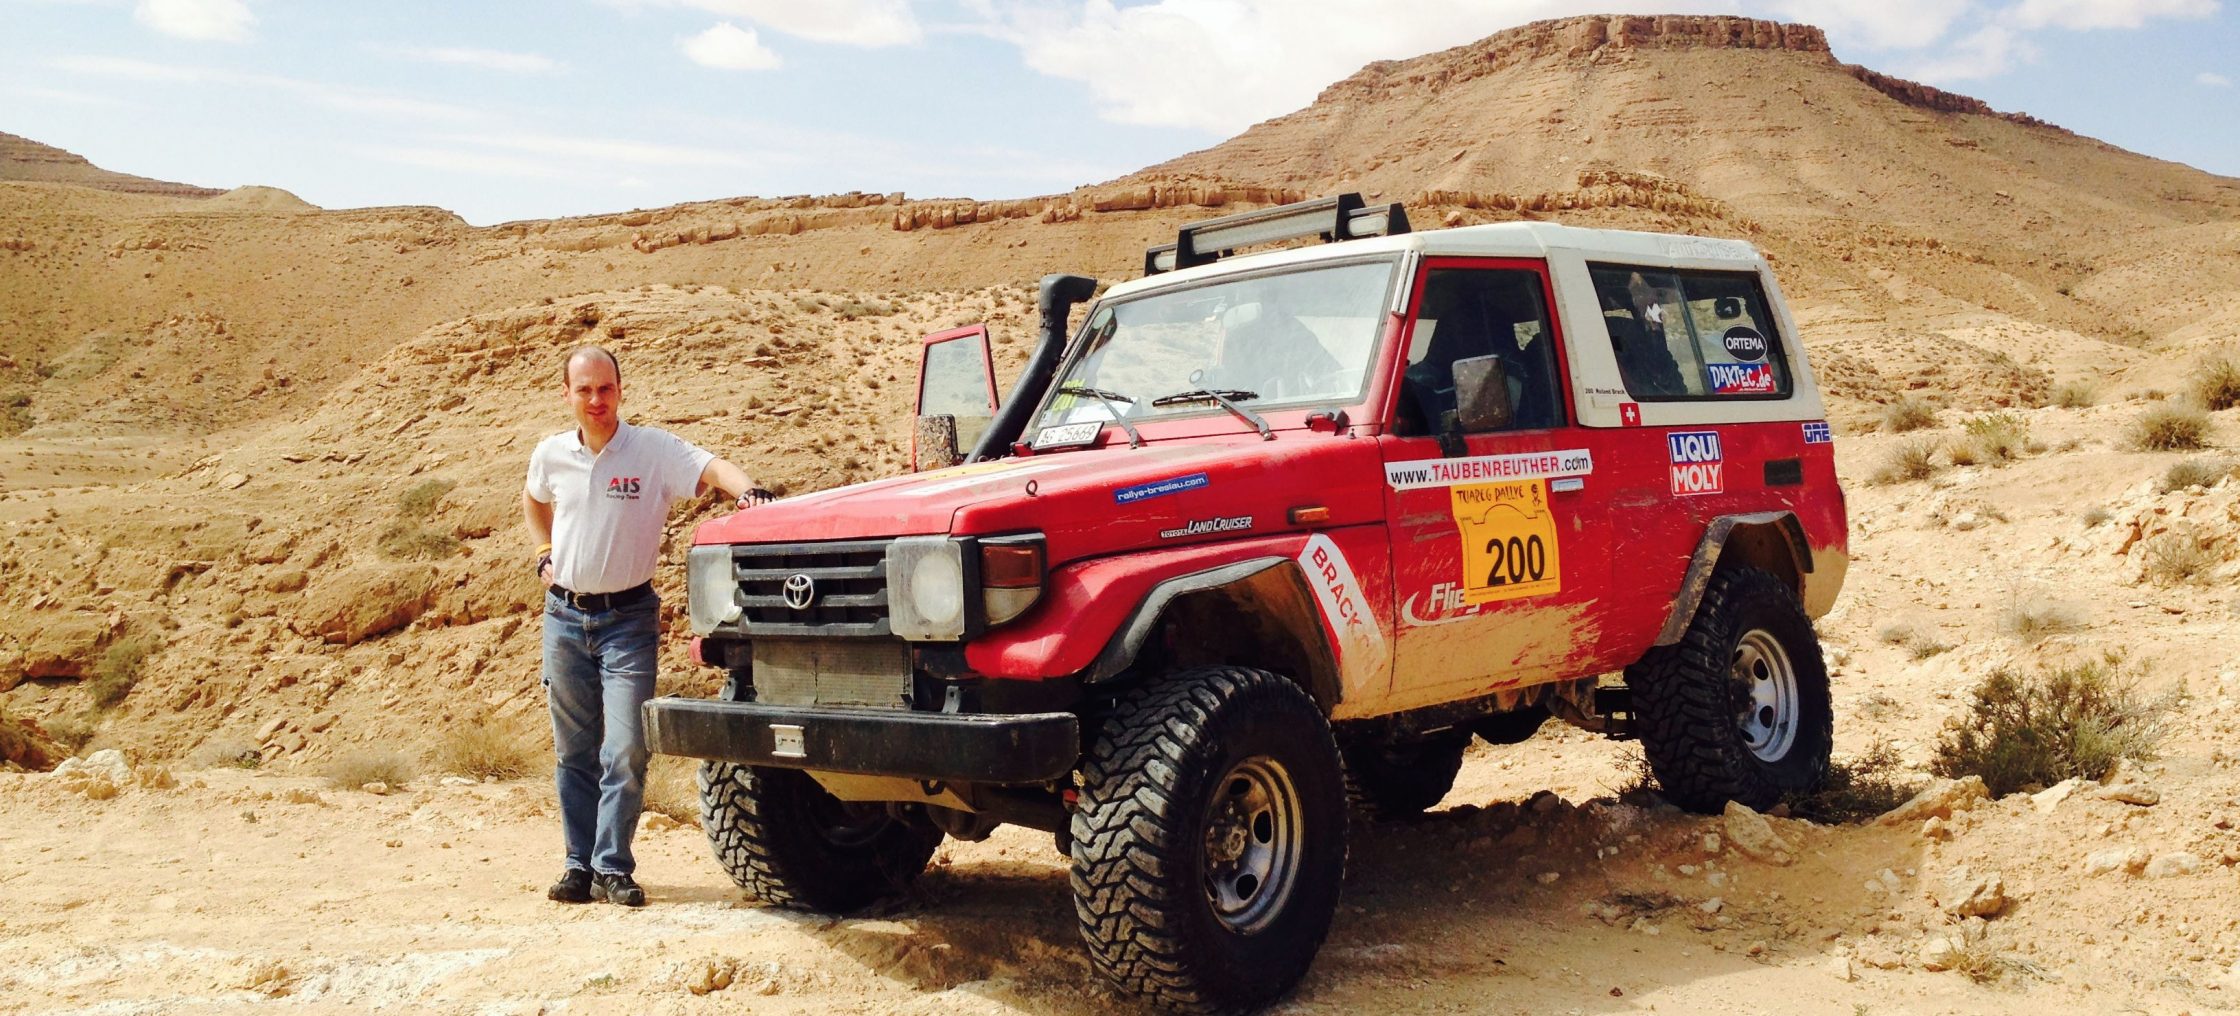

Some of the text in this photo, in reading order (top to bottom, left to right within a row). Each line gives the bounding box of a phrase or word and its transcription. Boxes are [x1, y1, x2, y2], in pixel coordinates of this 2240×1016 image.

[1725, 337, 1764, 350] ORTEMA
[1670, 435, 1720, 463] LIQUI
[1390, 455, 1589, 484] www.TAUBENREUTHER.com
[1672, 464, 1720, 493] MOLY
[607, 477, 640, 493] AIS
[1117, 476, 1206, 501] rallye-breslau.com
[1485, 534, 1545, 587] 200
